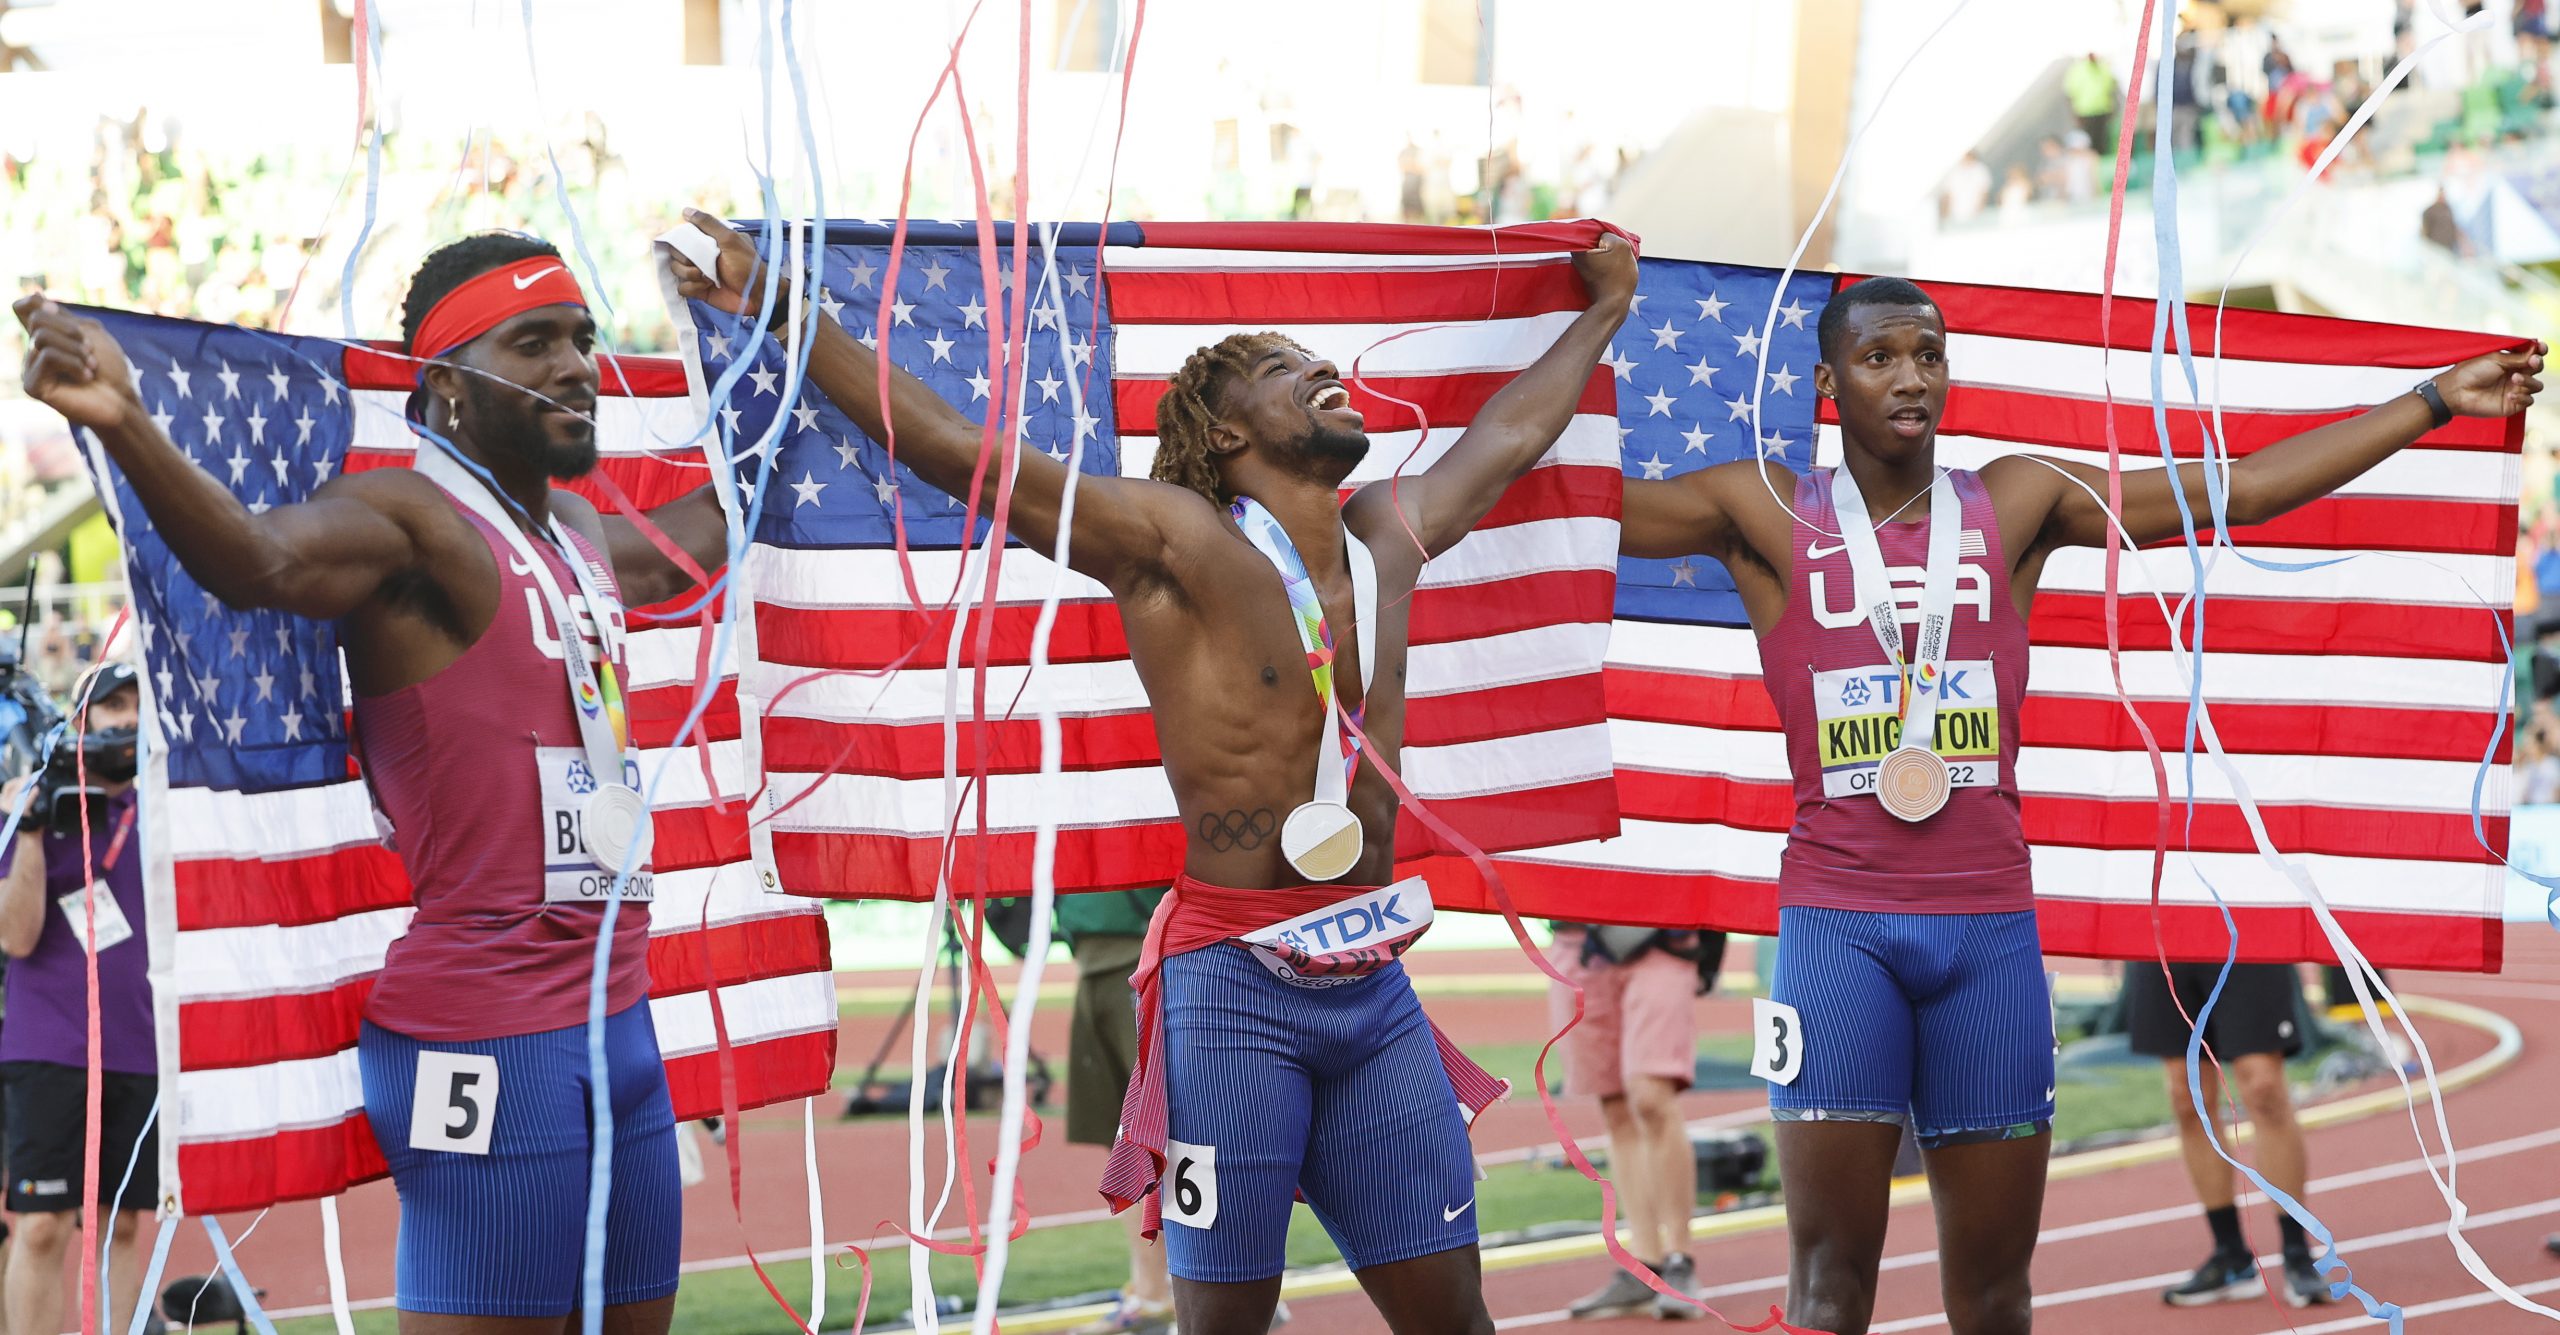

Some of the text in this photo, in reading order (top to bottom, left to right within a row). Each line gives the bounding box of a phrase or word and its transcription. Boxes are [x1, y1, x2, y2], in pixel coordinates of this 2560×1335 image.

[1809, 563, 1991, 629] USA
[1931, 615, 1944, 661] OREGON 22
[1870, 670, 1972, 704] TK
[1829, 711, 1990, 759] KNIGTON
[1300, 892, 1411, 950] TDK
[1770, 1016, 1788, 1072] 3
[445, 1071, 480, 1140] 5
[1175, 1156, 1202, 1216] 6
